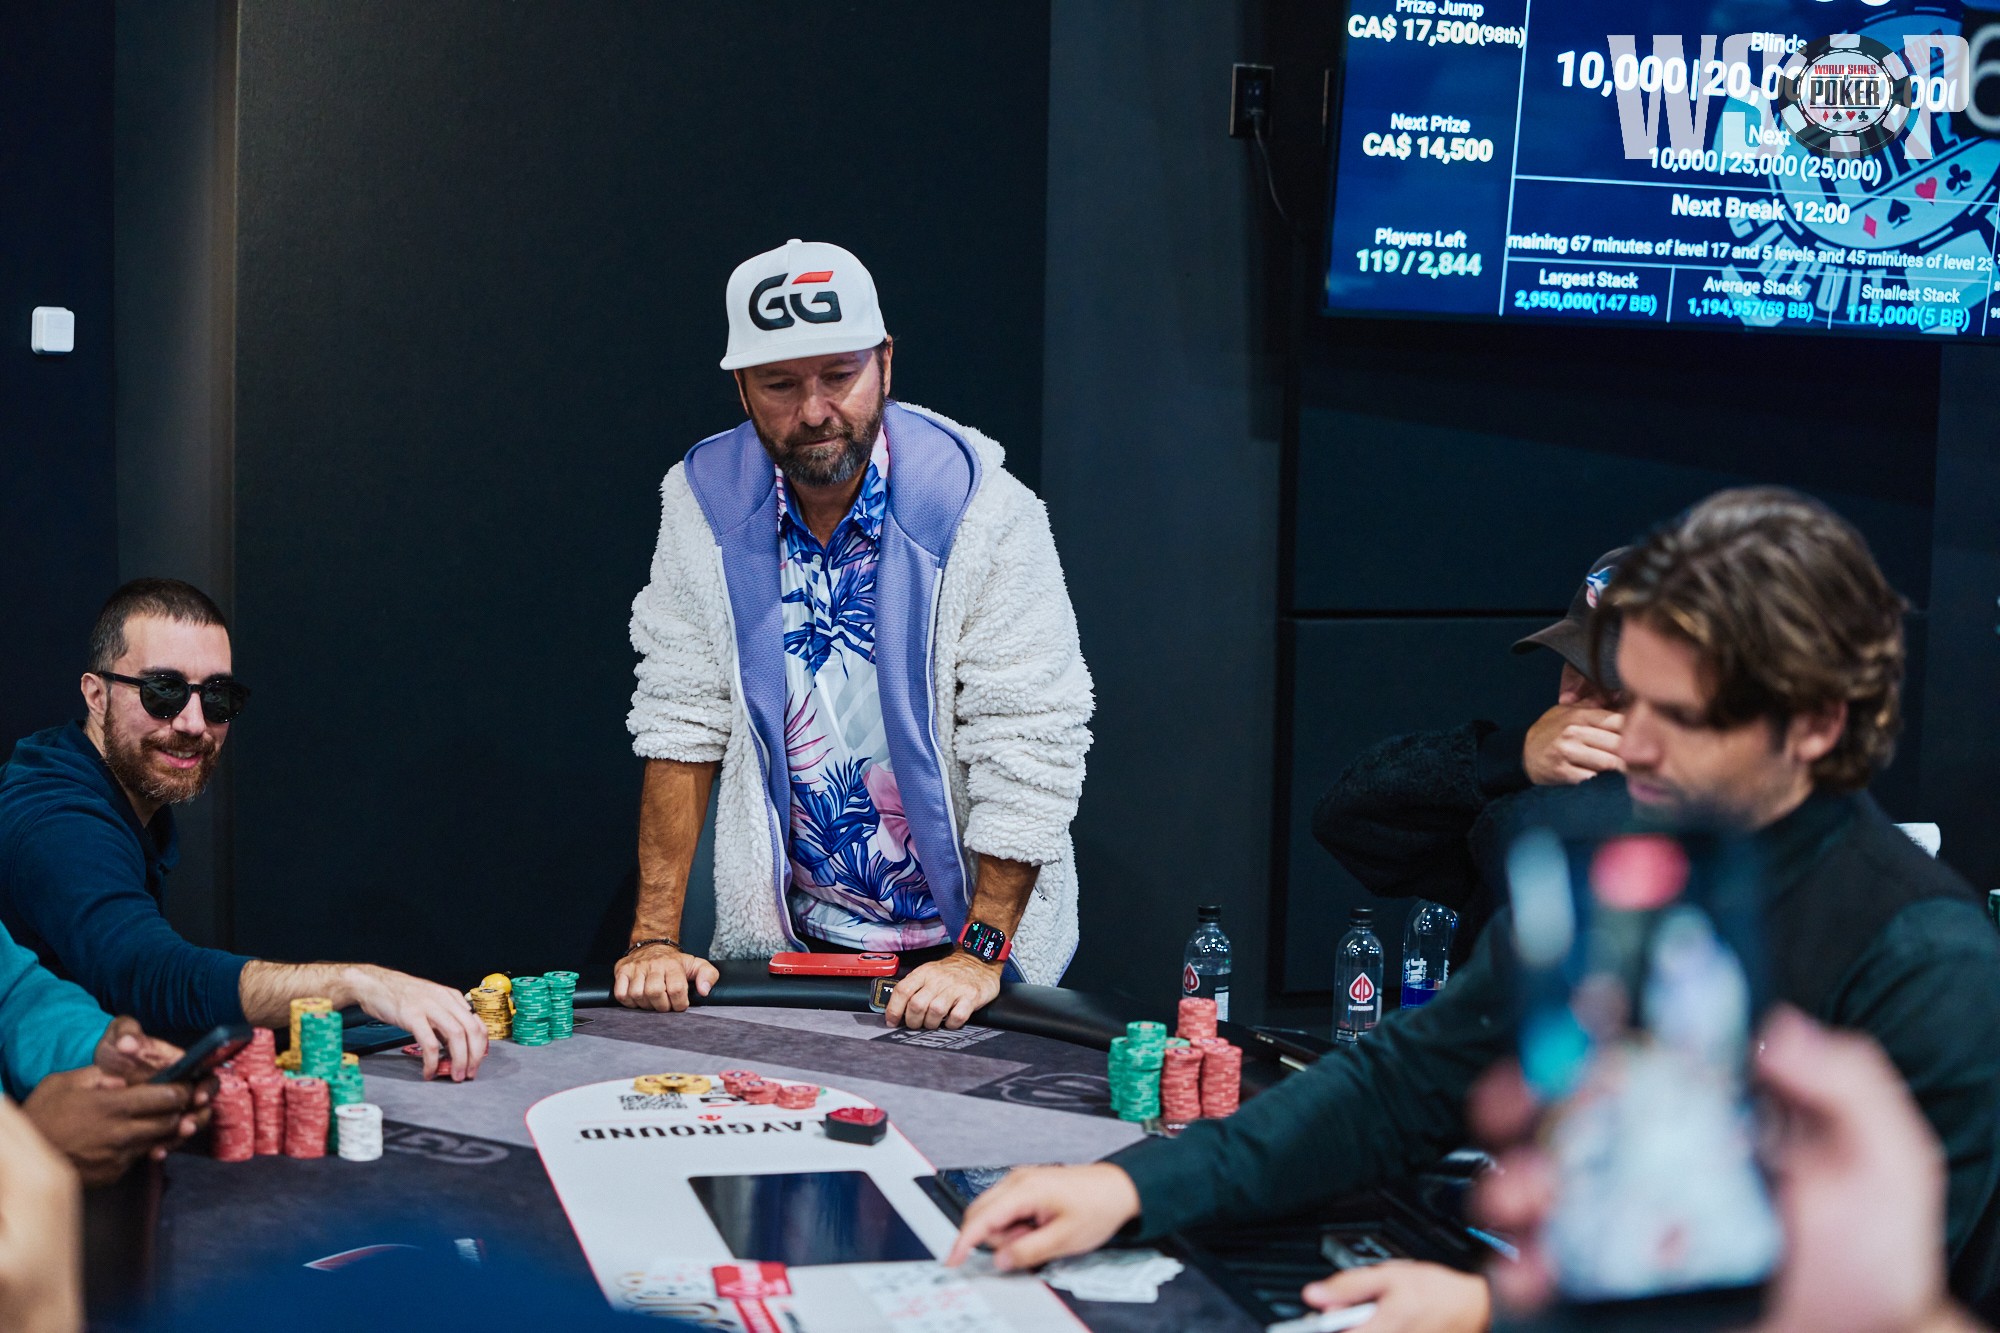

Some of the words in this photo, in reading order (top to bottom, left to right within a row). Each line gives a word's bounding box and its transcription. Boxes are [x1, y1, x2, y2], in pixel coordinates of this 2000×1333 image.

[1438, 0, 1484, 21] Jump
[1348, 14, 1398, 42] CA$
[1750, 31, 1808, 54] Blinds
[1390, 112, 1429, 131] Next
[1430, 115, 1471, 133] Prize
[1748, 123, 1792, 146] Next
[1362, 132, 1412, 160] CA$
[1416, 136, 1494, 164] 14,500
[1671, 193, 1721, 218] Next
[1725, 196, 1786, 221] Break
[1794, 200, 1850, 225] 12:00
[1375, 227, 1433, 249] Players
[1434, 230, 1467, 248] Left
[1570, 235, 1592, 252] 67
[1592, 236, 1653, 255] minutes
[1655, 239, 1673, 256] of
[1674, 239, 1708, 257] level
[1710, 242, 1730, 258] 17
[1731, 245, 1759, 260] and
[1762, 245, 1773, 260] 5
[1774, 245, 1815, 262] levels
[1817, 248, 1845, 264] and
[1846, 249, 1867, 266] 45
[1868, 251, 1923, 268] minutes
[1926, 254, 1942, 270] of
[1943, 254, 1974, 271] level
[1538, 268, 1596, 289] Largest
[1597, 271, 1639, 289] Stack
[1703, 276, 1760, 297] Average
[1762, 279, 1803, 297] Stack
[748, 270, 843, 331] GG
[1861, 283, 1921, 302] Smallest
[1922, 286, 1961, 304] Stack
